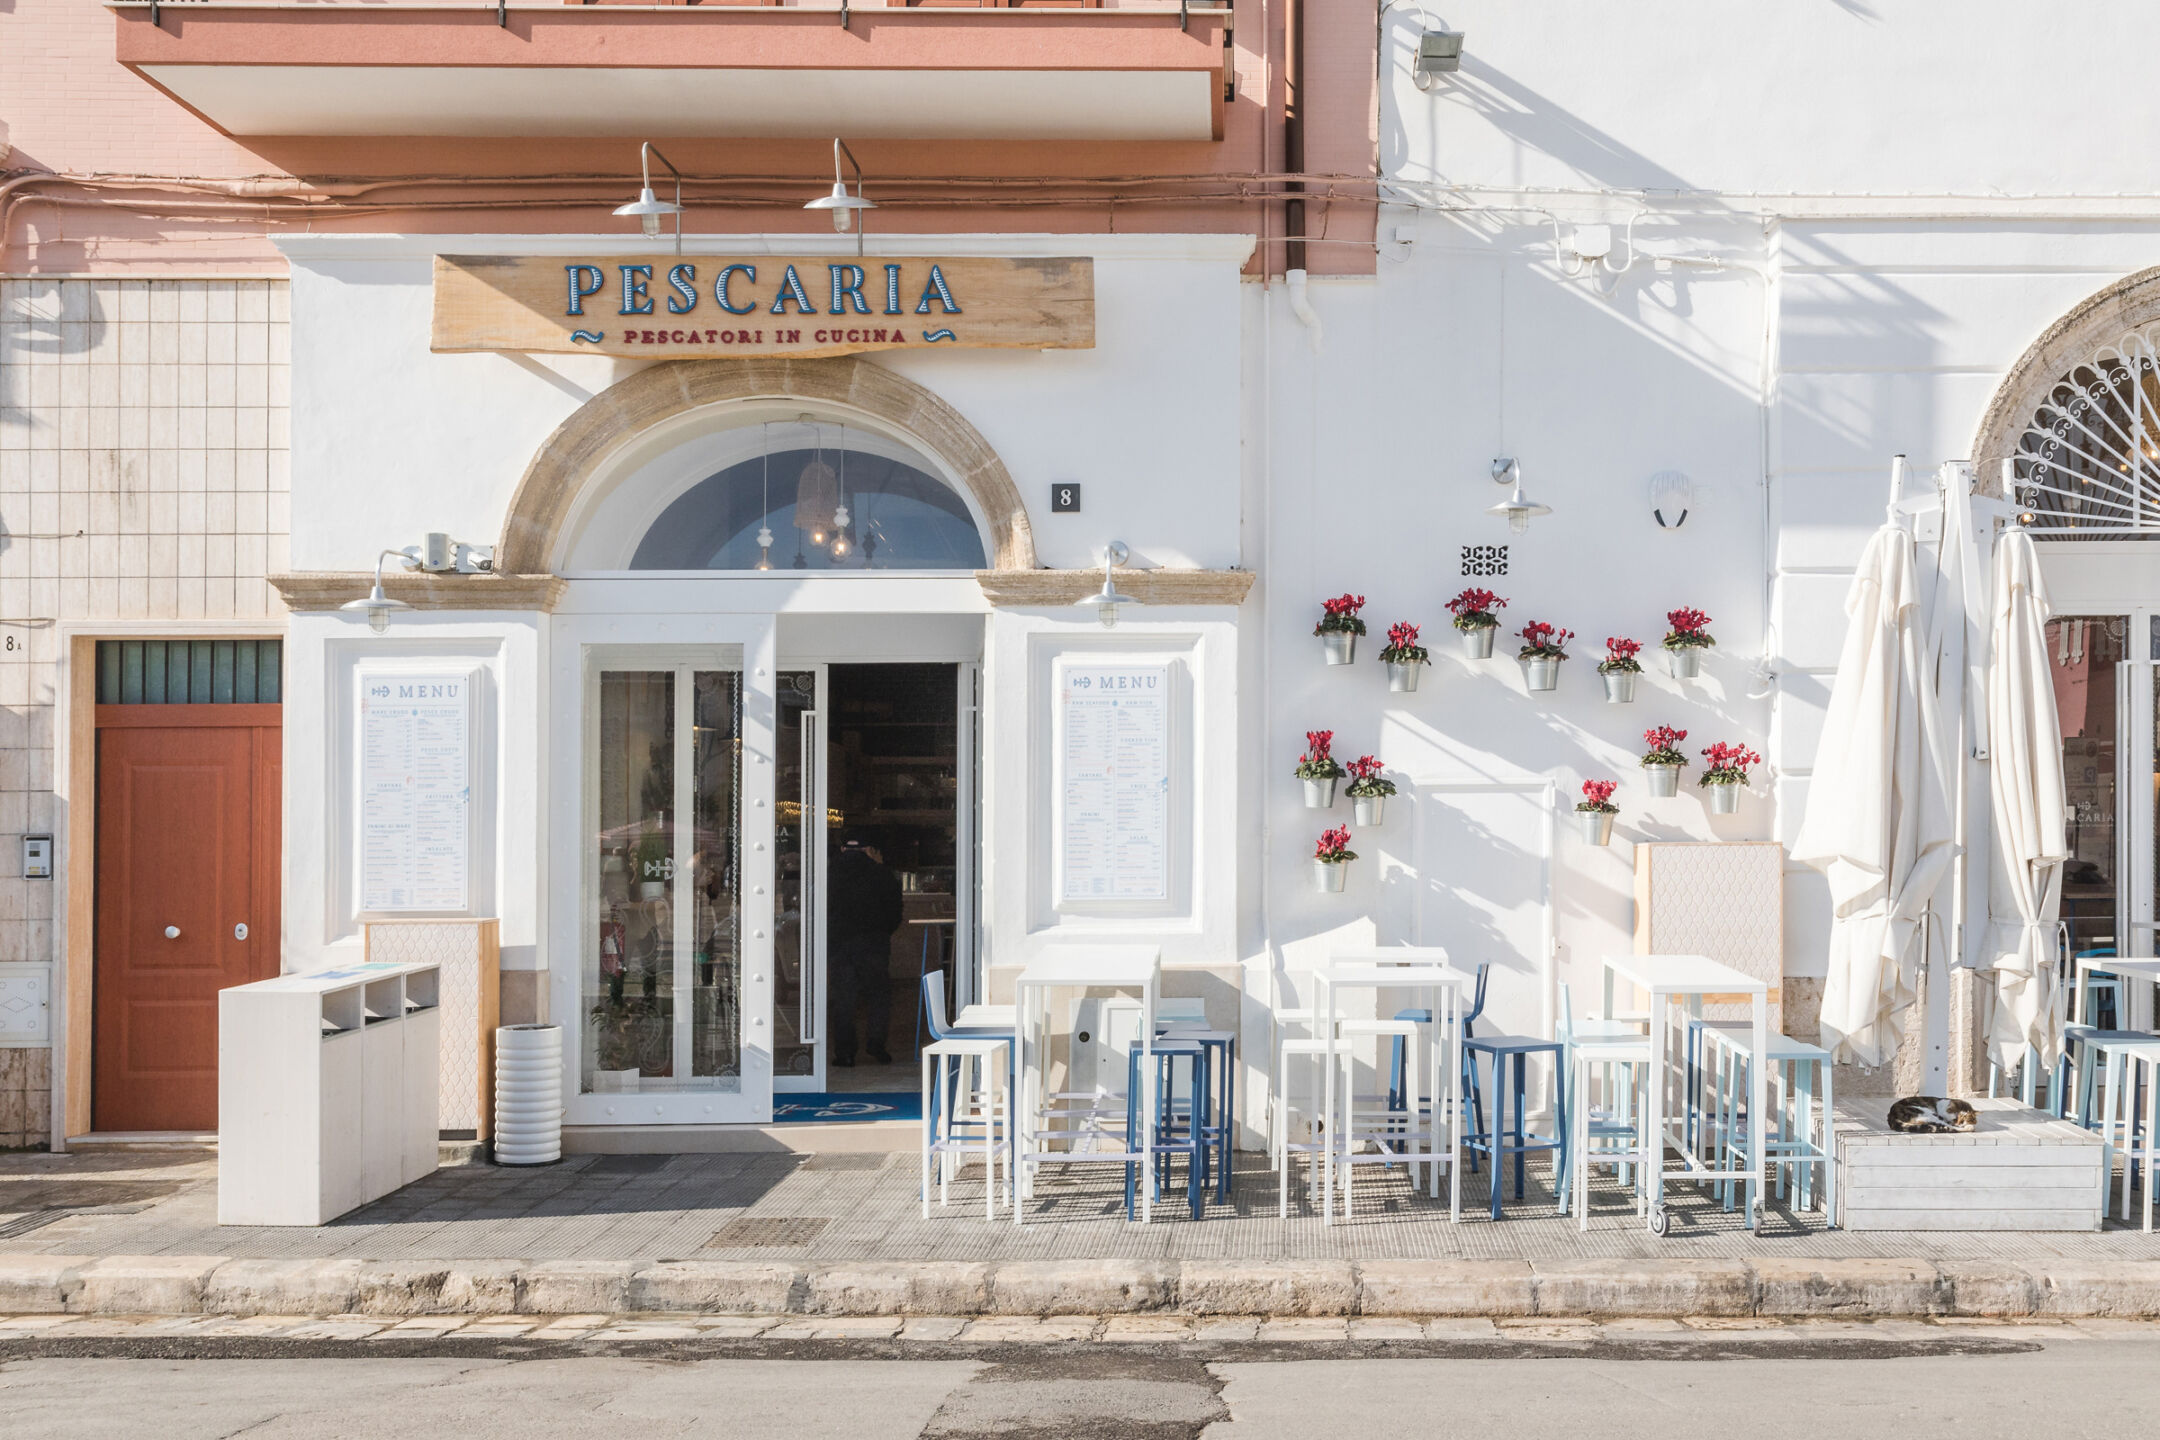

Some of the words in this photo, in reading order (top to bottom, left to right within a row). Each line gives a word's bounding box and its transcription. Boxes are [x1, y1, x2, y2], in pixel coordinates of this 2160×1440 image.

[565, 264, 962, 315] PESCARIA
[624, 329, 762, 344] PESCATORI
[776, 330, 801, 344] IN
[815, 329, 906, 344] CUCINA
[1060, 488, 1071, 506] 8
[1100, 676, 1157, 689] MENU
[399, 685, 458, 698] MENU
